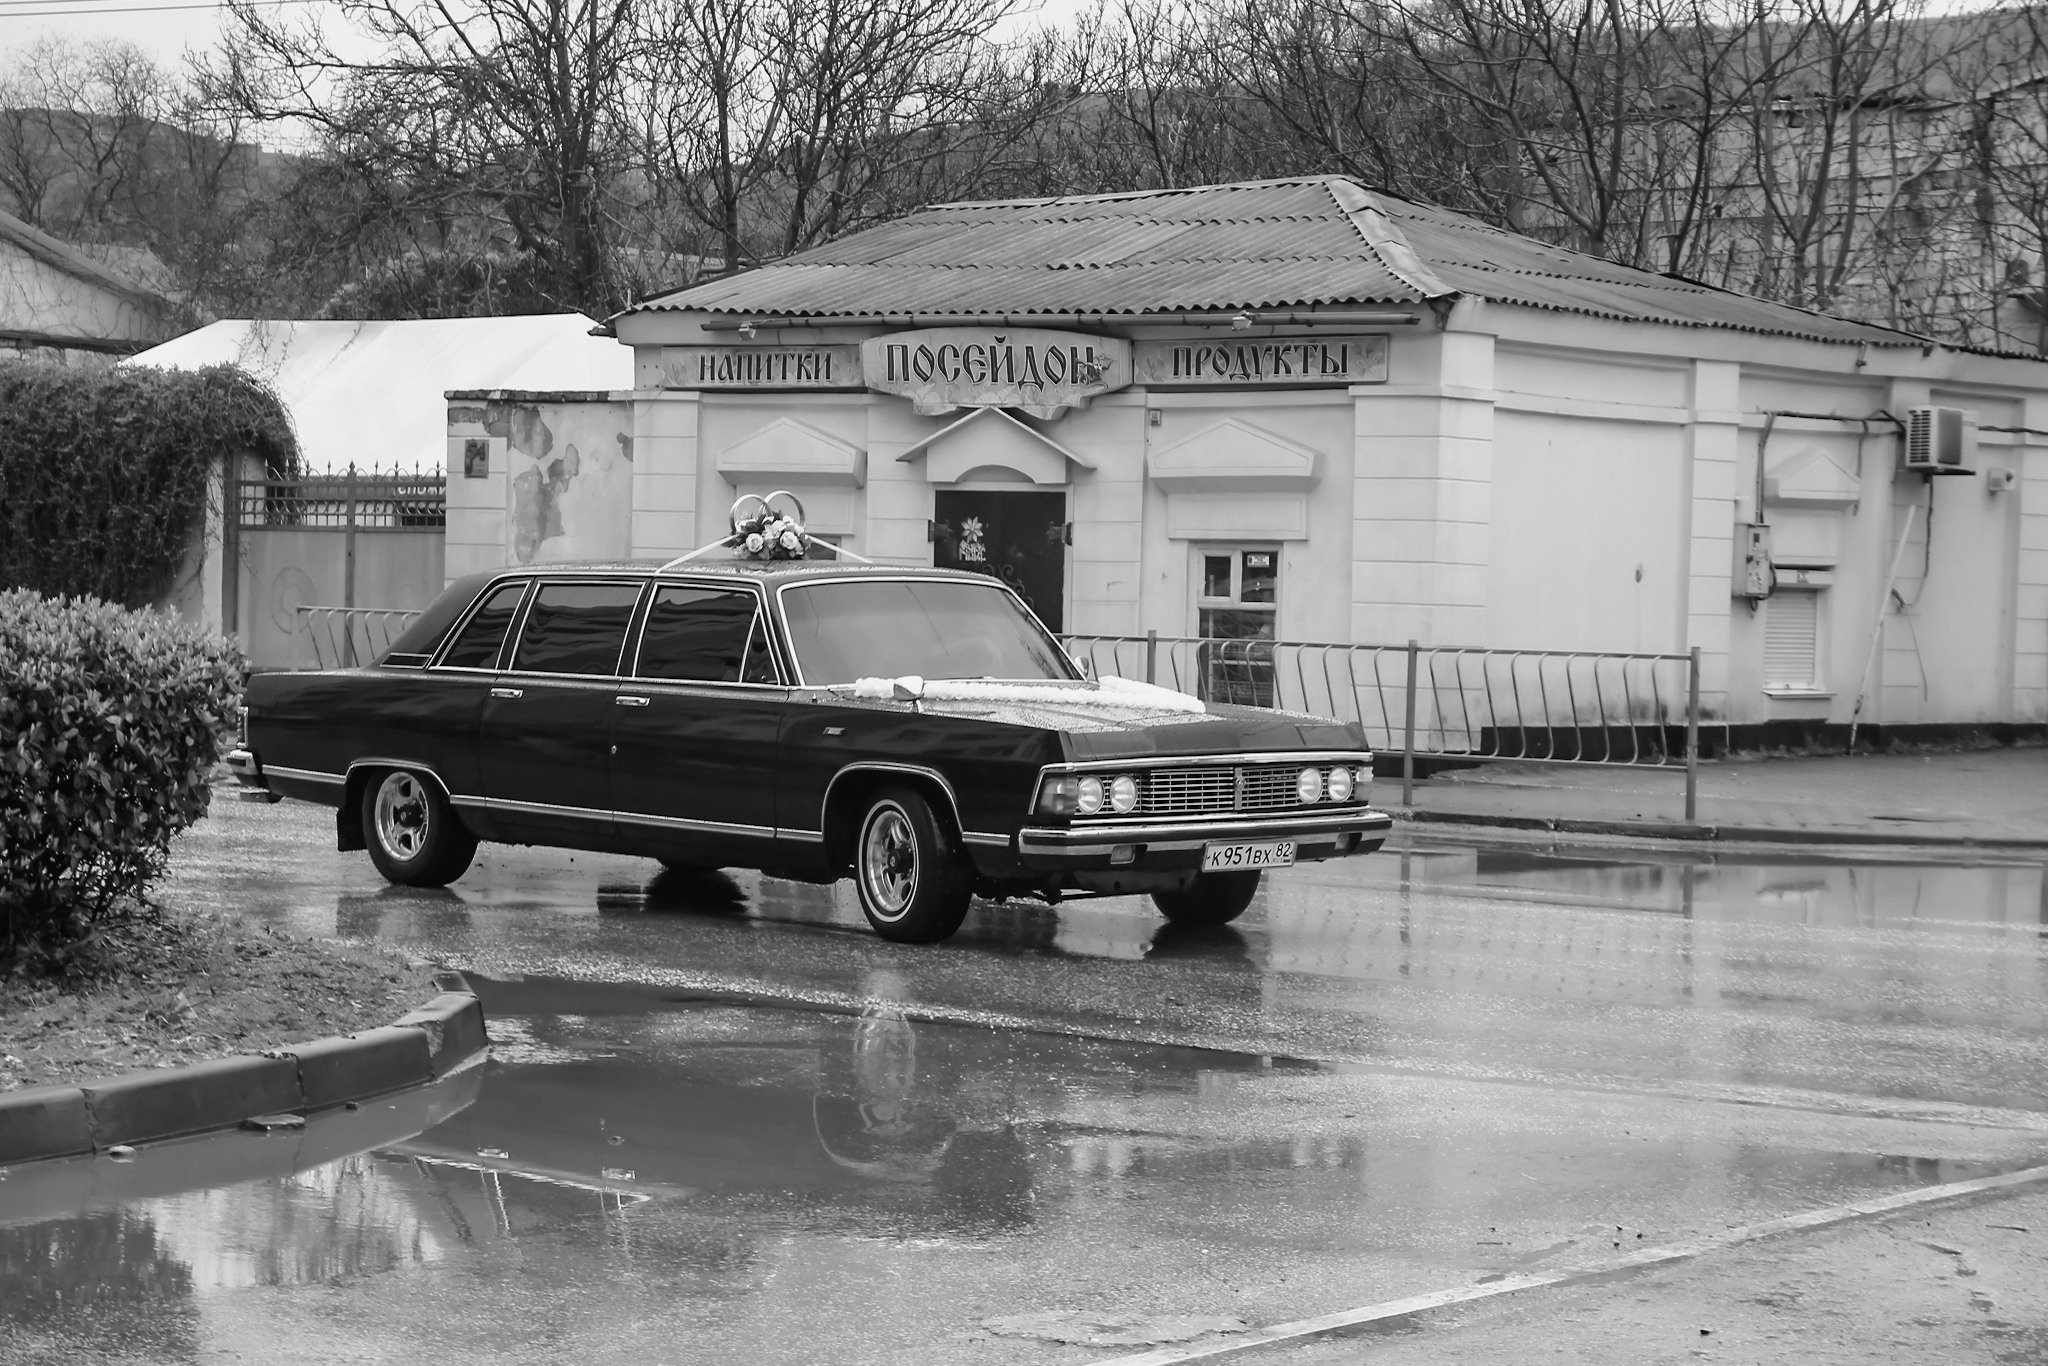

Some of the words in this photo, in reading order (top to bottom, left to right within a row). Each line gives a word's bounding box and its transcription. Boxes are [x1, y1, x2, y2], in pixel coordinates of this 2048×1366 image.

[700, 352, 832, 381] НАПИТКИ
[886, 334, 1099, 393] ПОСЕЙДОН
[1173, 343, 1348, 382] ПРОДУКТЫ
